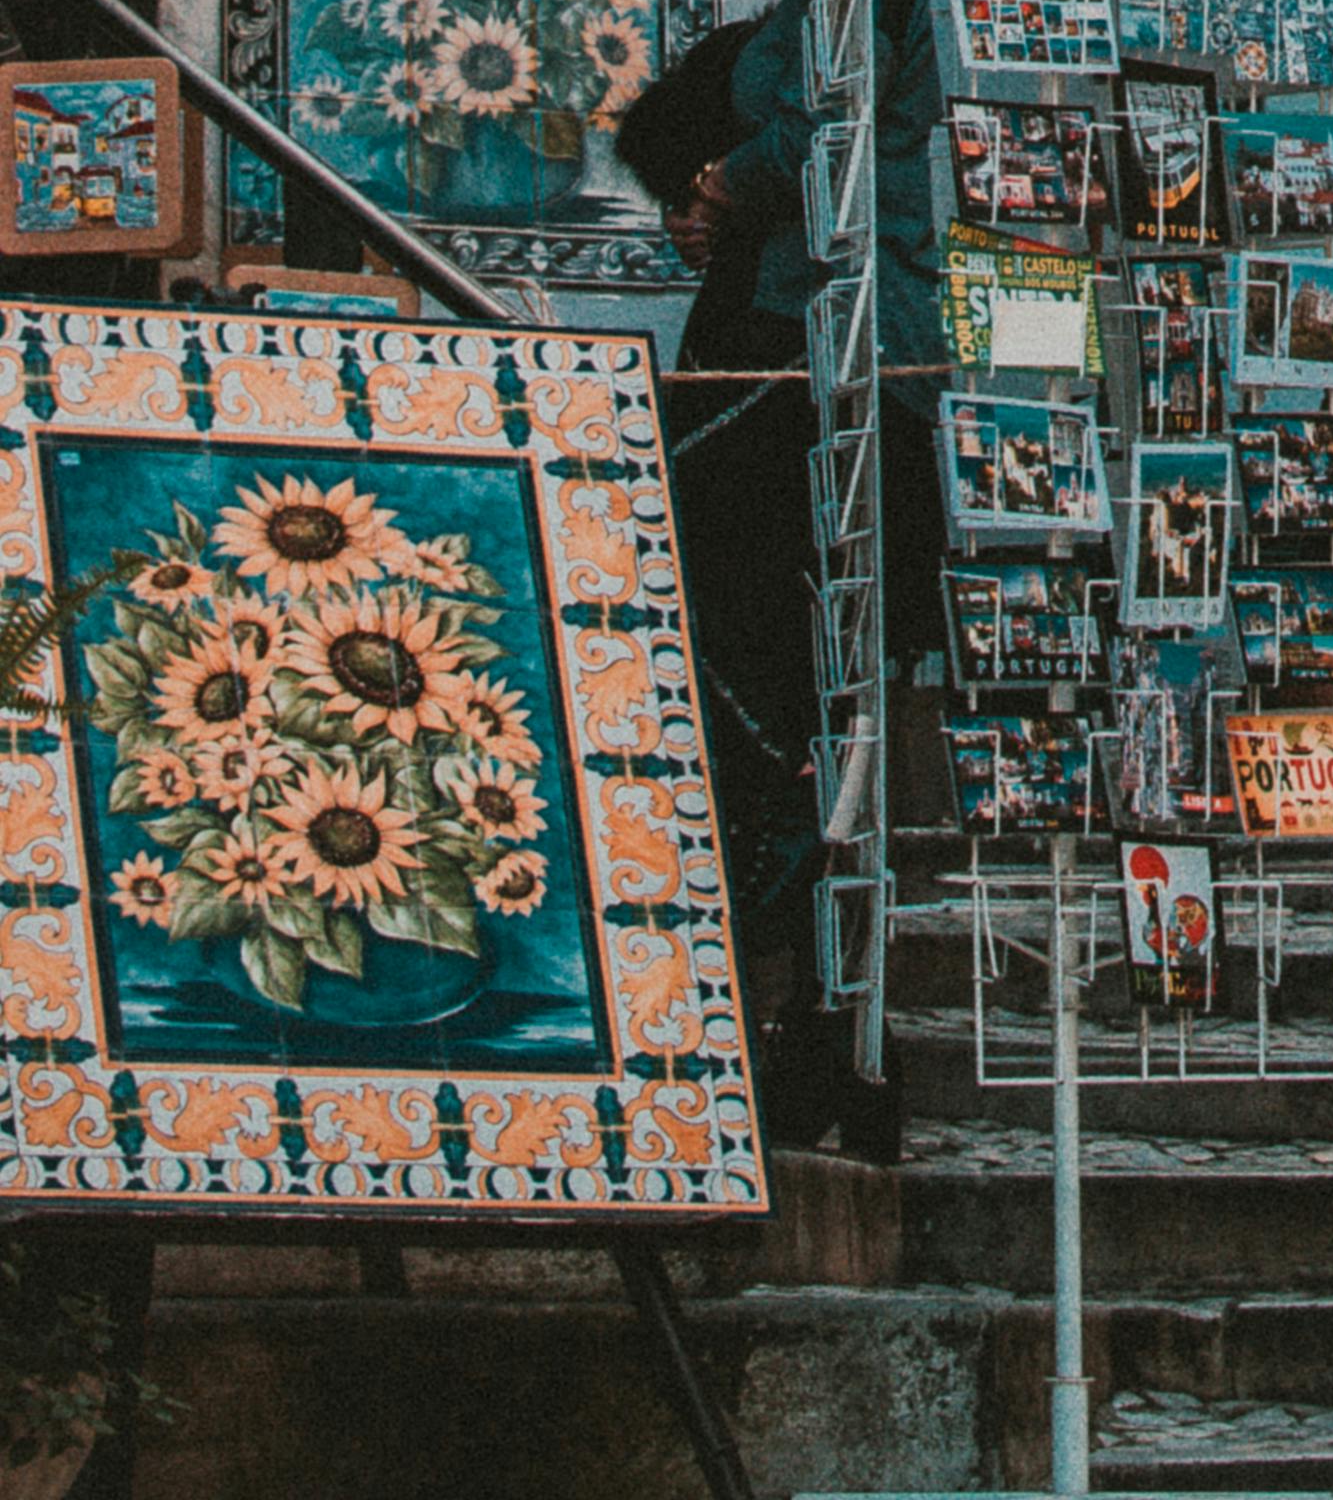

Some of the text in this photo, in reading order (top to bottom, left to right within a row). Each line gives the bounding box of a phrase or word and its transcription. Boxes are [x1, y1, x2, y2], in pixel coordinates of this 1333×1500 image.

[948, 222, 988, 248] PORTO
[1022, 256, 1077, 277] CASTELO
[954, 317, 978, 365] ROCA
[976, 658, 1096, 675] PORTUGAL
